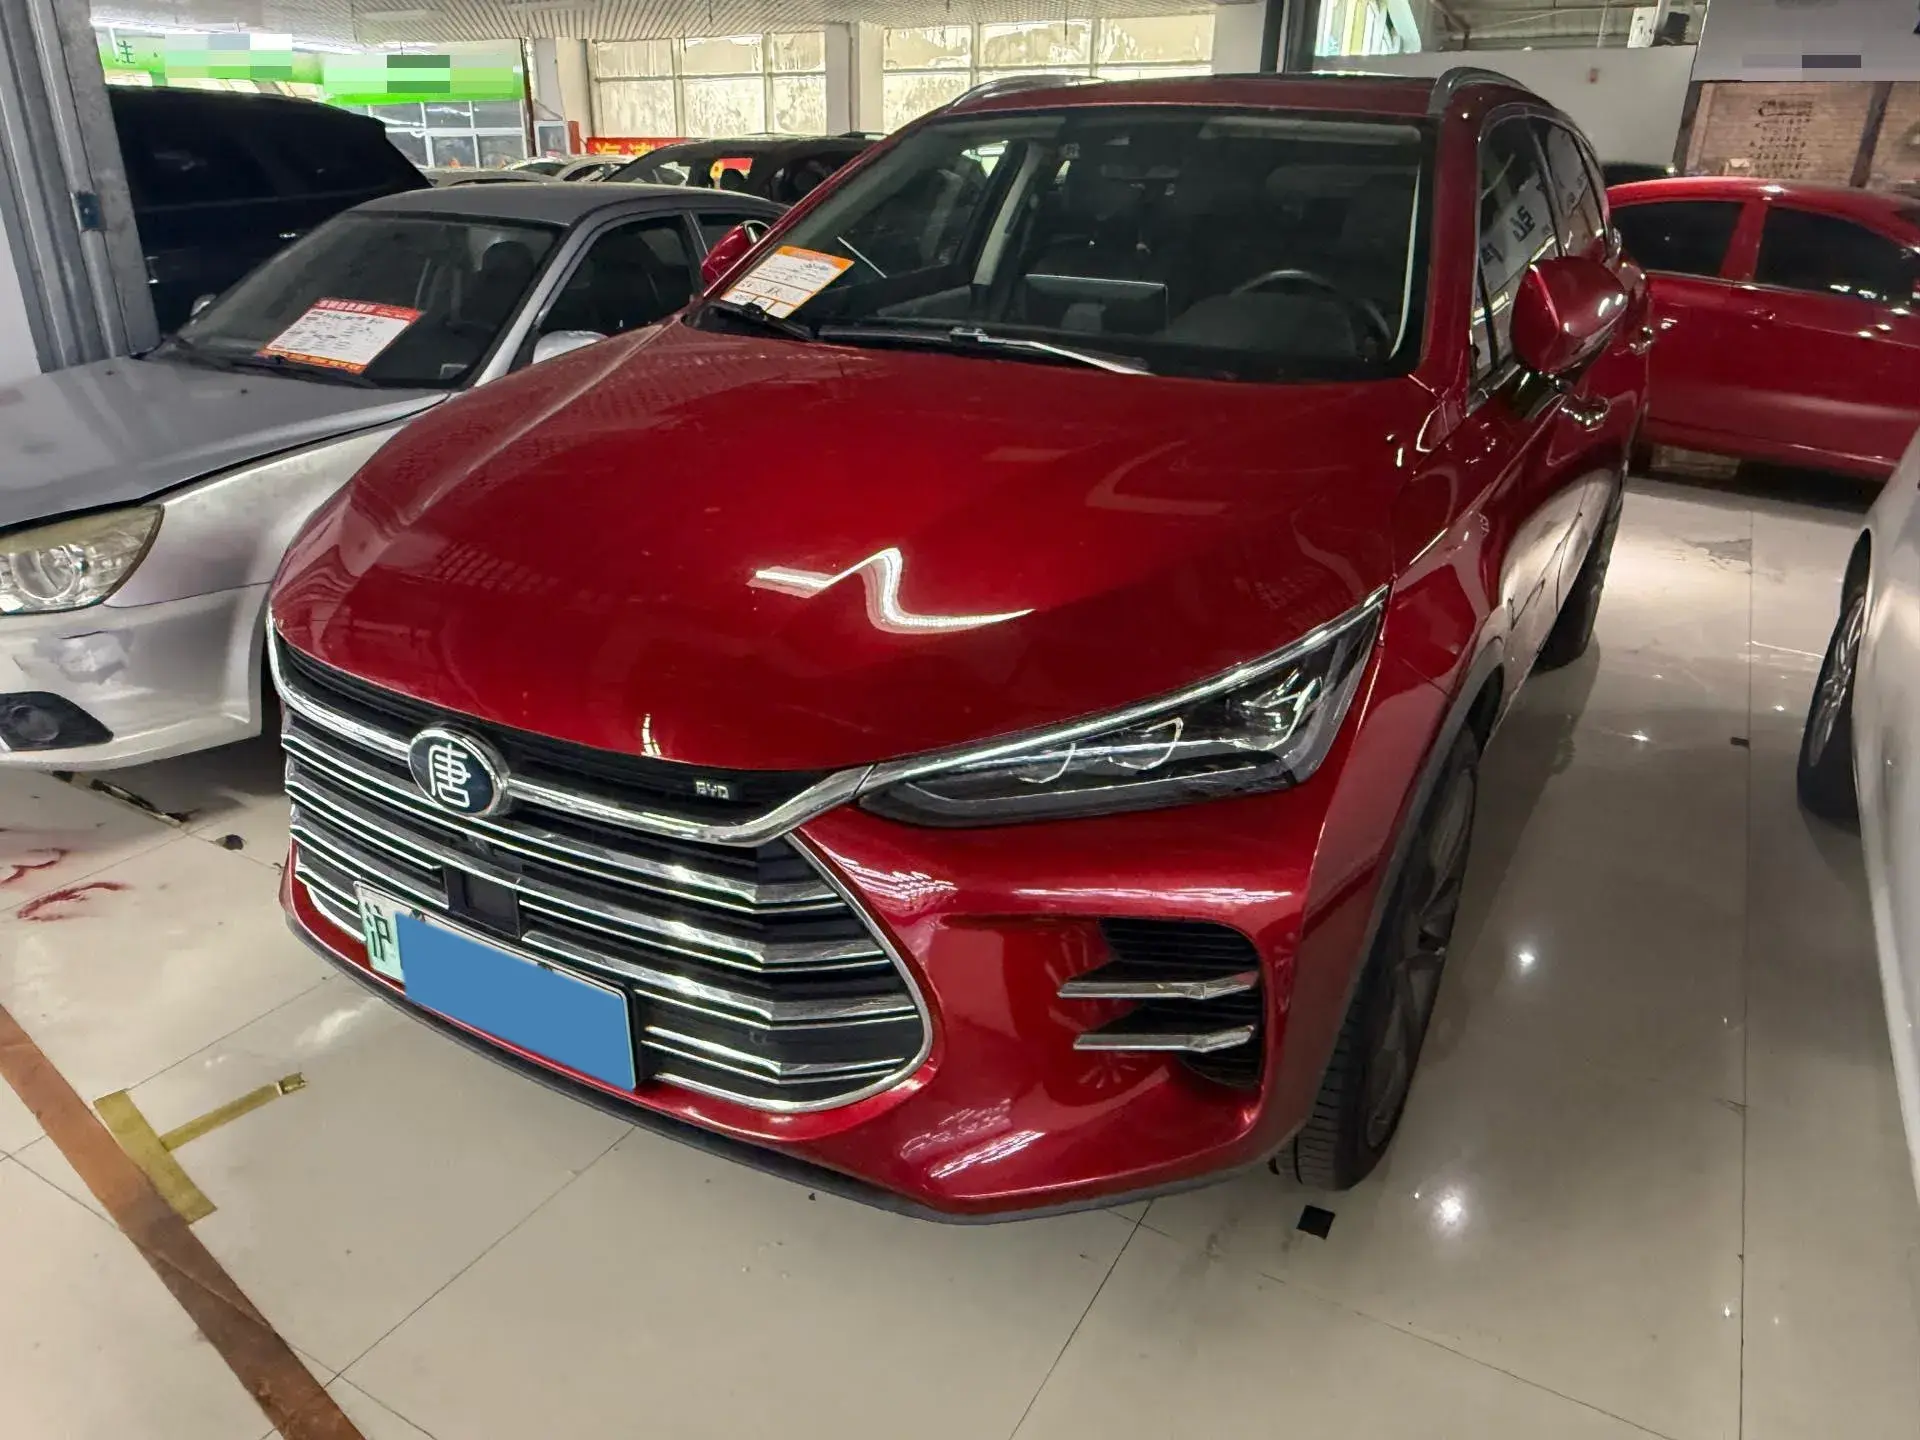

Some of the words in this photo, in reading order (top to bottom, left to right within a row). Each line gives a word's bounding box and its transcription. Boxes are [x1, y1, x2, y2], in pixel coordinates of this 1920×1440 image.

[428, 742, 472, 808] 唐
[695, 780, 730, 800] BYD
[364, 901, 393, 963] 沪
